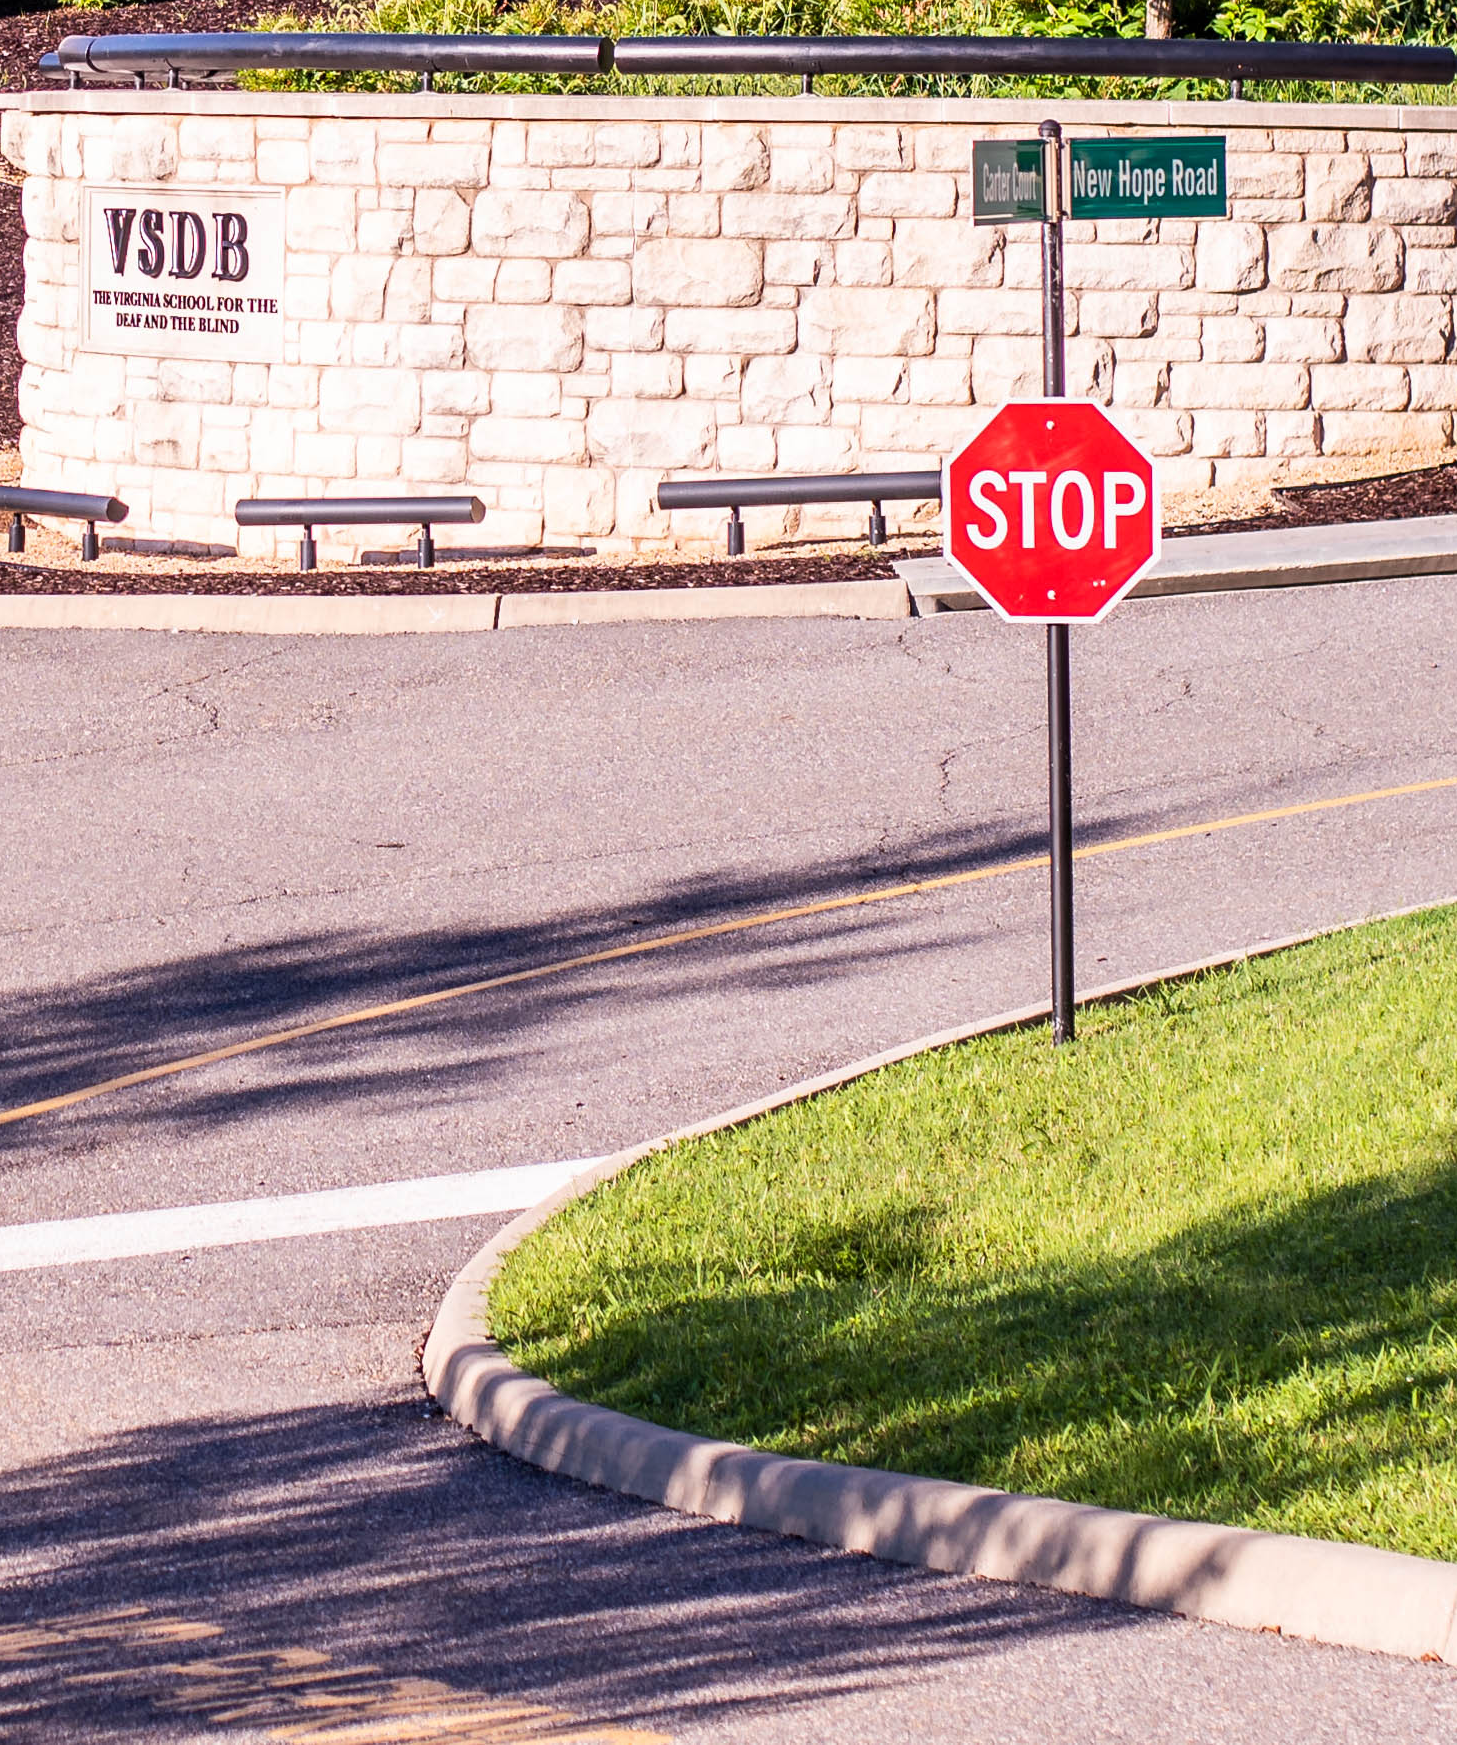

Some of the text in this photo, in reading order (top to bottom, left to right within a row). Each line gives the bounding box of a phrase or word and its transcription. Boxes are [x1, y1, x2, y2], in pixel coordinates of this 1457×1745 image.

[982, 159, 1037, 203] Carter Court
[1073, 158, 1218, 205] New Hope Road
[103, 208, 250, 282] VSDB
[93, 290, 278, 314] THE VIRGINIA SCHOOL FOR THE
[116, 312, 240, 334] DEAF AND THE BLIND
[965, 469, 1147, 551] STOP
